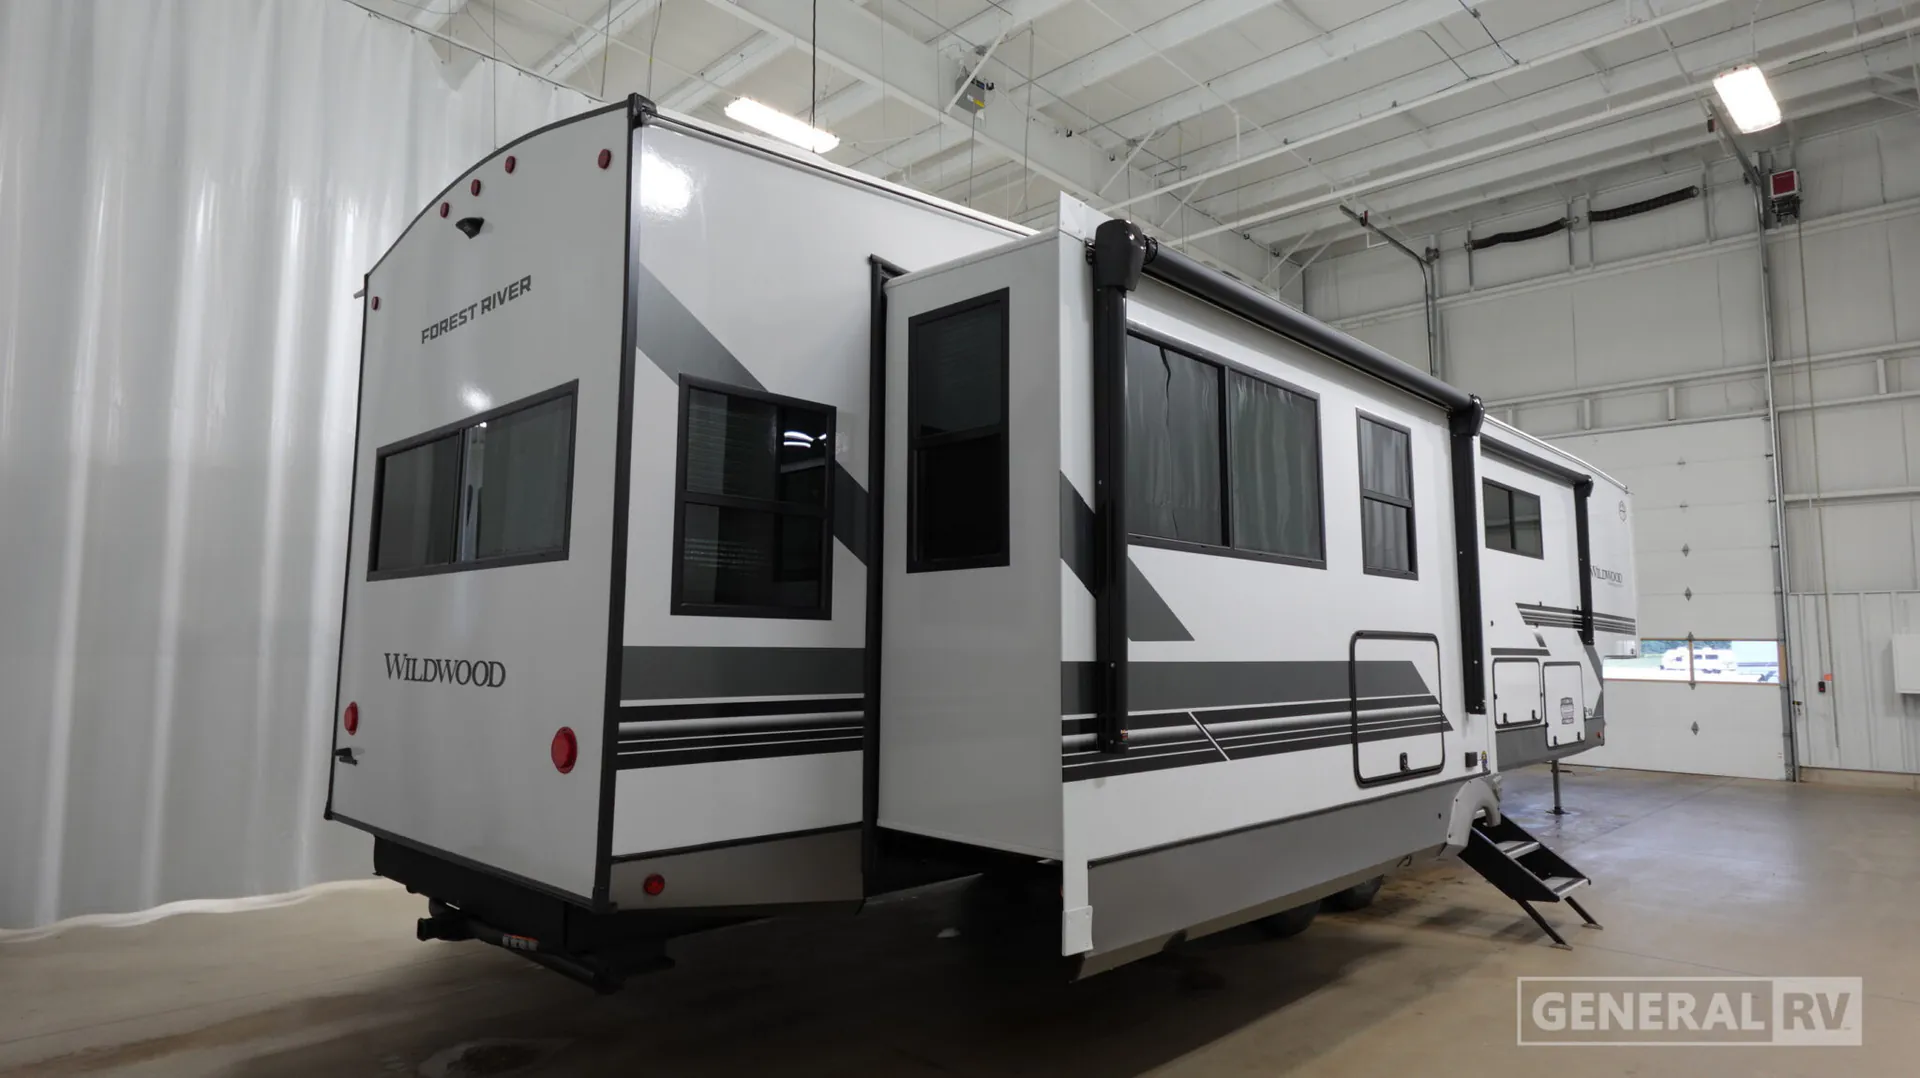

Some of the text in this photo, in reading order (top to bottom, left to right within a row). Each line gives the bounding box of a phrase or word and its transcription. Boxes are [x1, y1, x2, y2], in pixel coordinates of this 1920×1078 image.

[421, 275, 531, 345] FOREST RIVER
[384, 652, 506, 688] WILDWOOD
